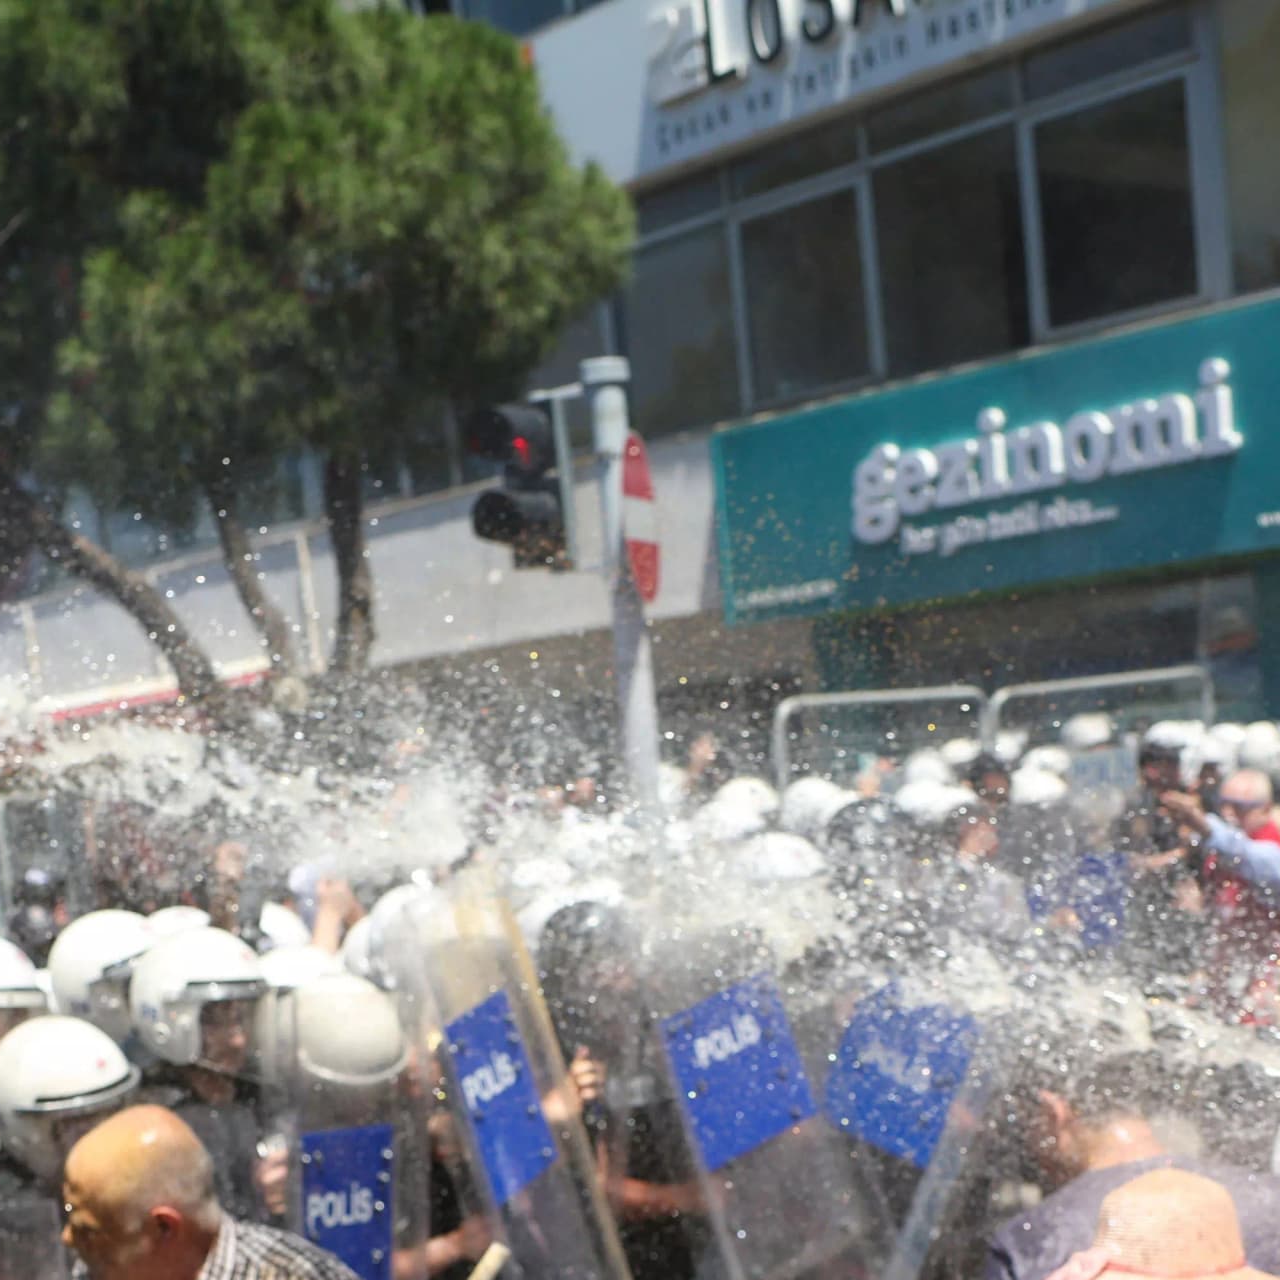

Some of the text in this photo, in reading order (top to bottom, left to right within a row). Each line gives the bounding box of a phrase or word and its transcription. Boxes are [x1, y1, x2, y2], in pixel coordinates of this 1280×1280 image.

[851, 356, 1246, 545] gezinomi
[461, 1049, 517, 1111] POLİS
[305, 1181, 375, 1239] POLİS
